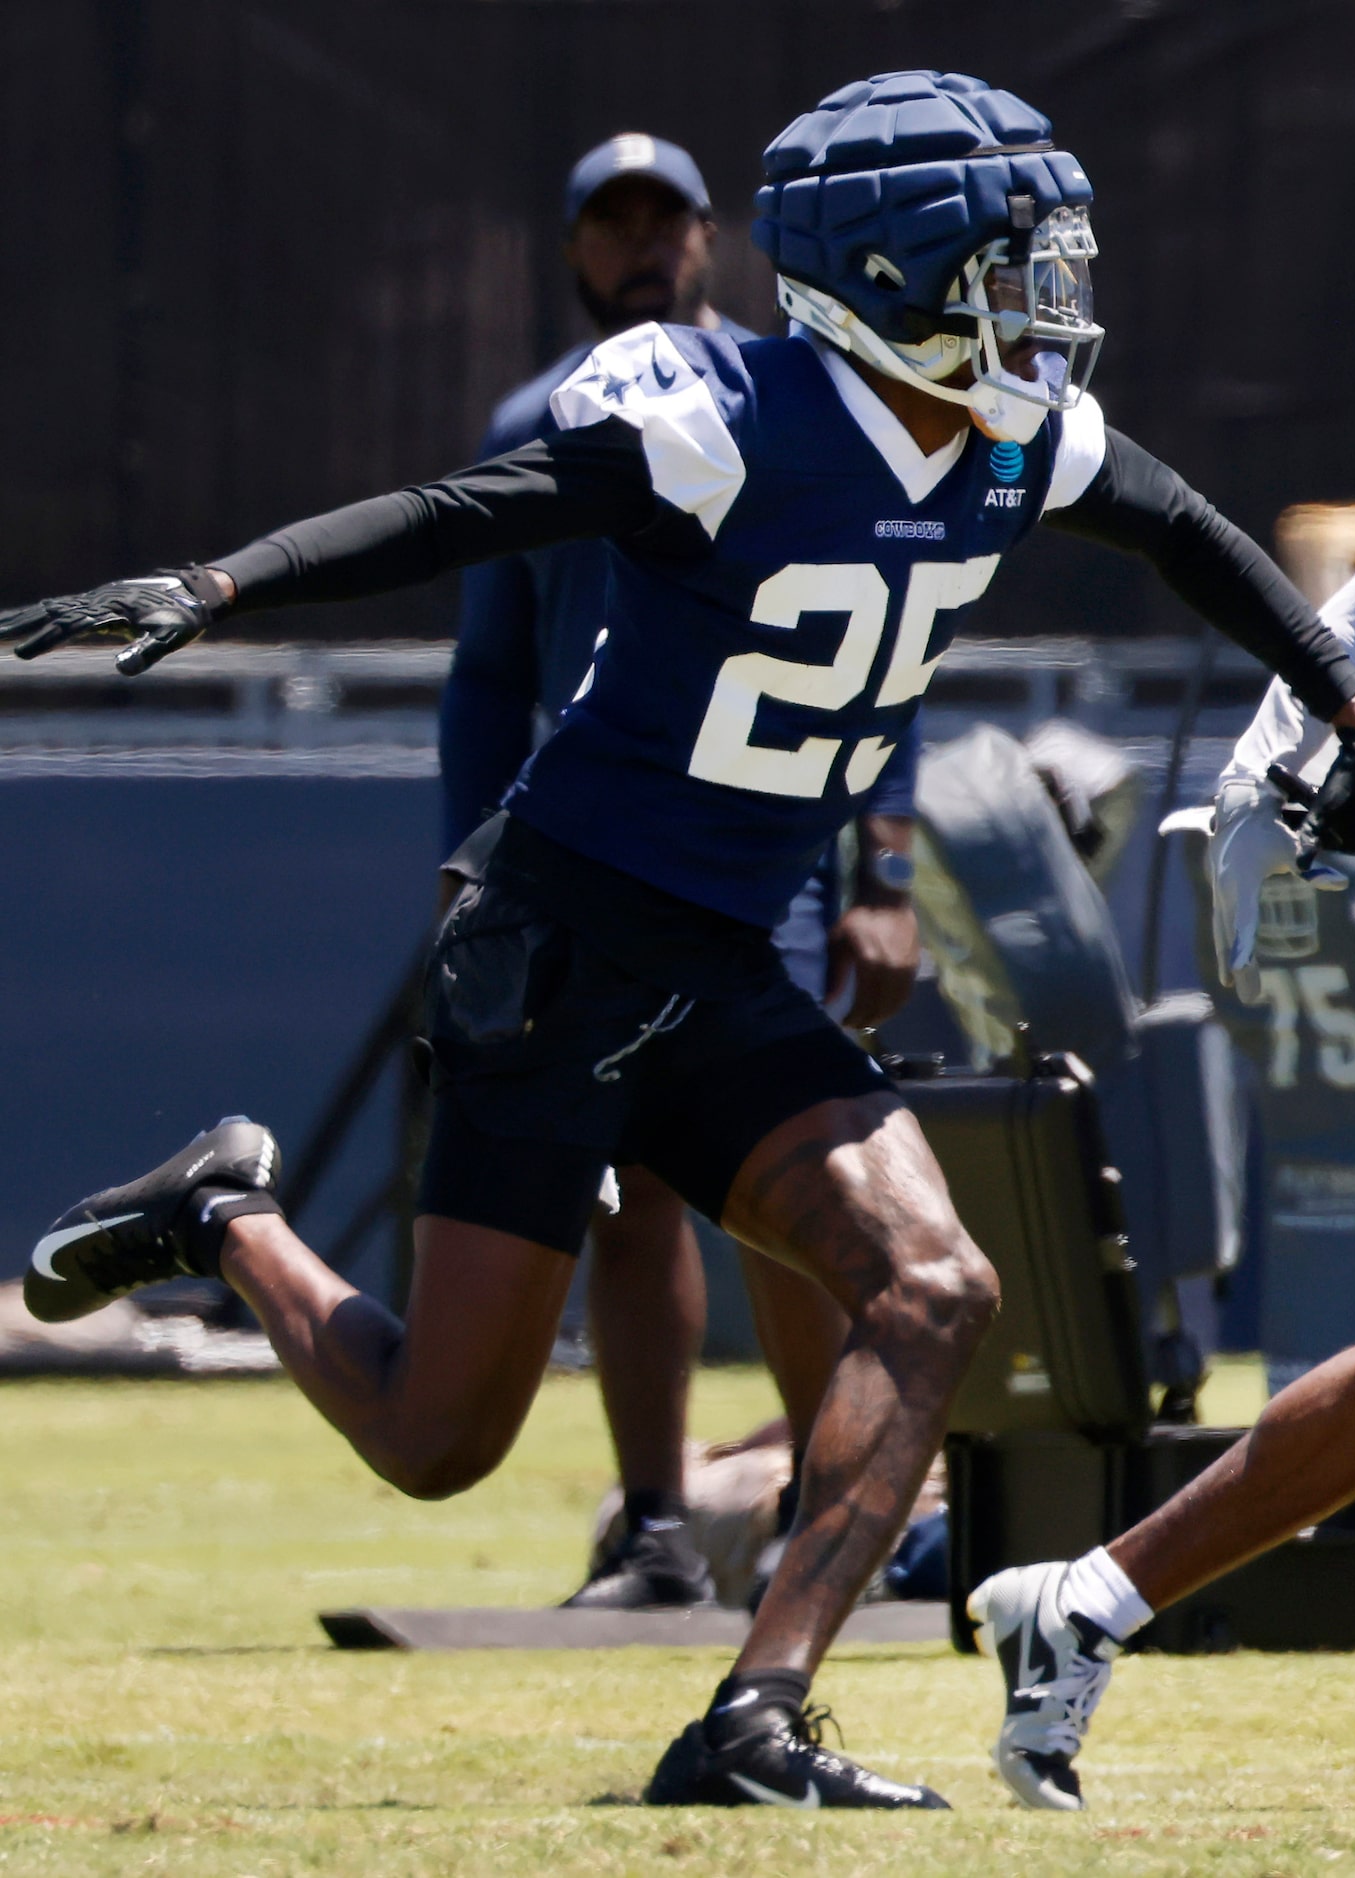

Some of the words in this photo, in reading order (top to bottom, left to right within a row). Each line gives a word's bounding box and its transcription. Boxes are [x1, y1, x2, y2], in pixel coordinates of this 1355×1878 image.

[984, 488, 1027, 508] AT&T
[874, 519, 946, 541] COWBOYS
[687, 553, 1002, 798] 25
